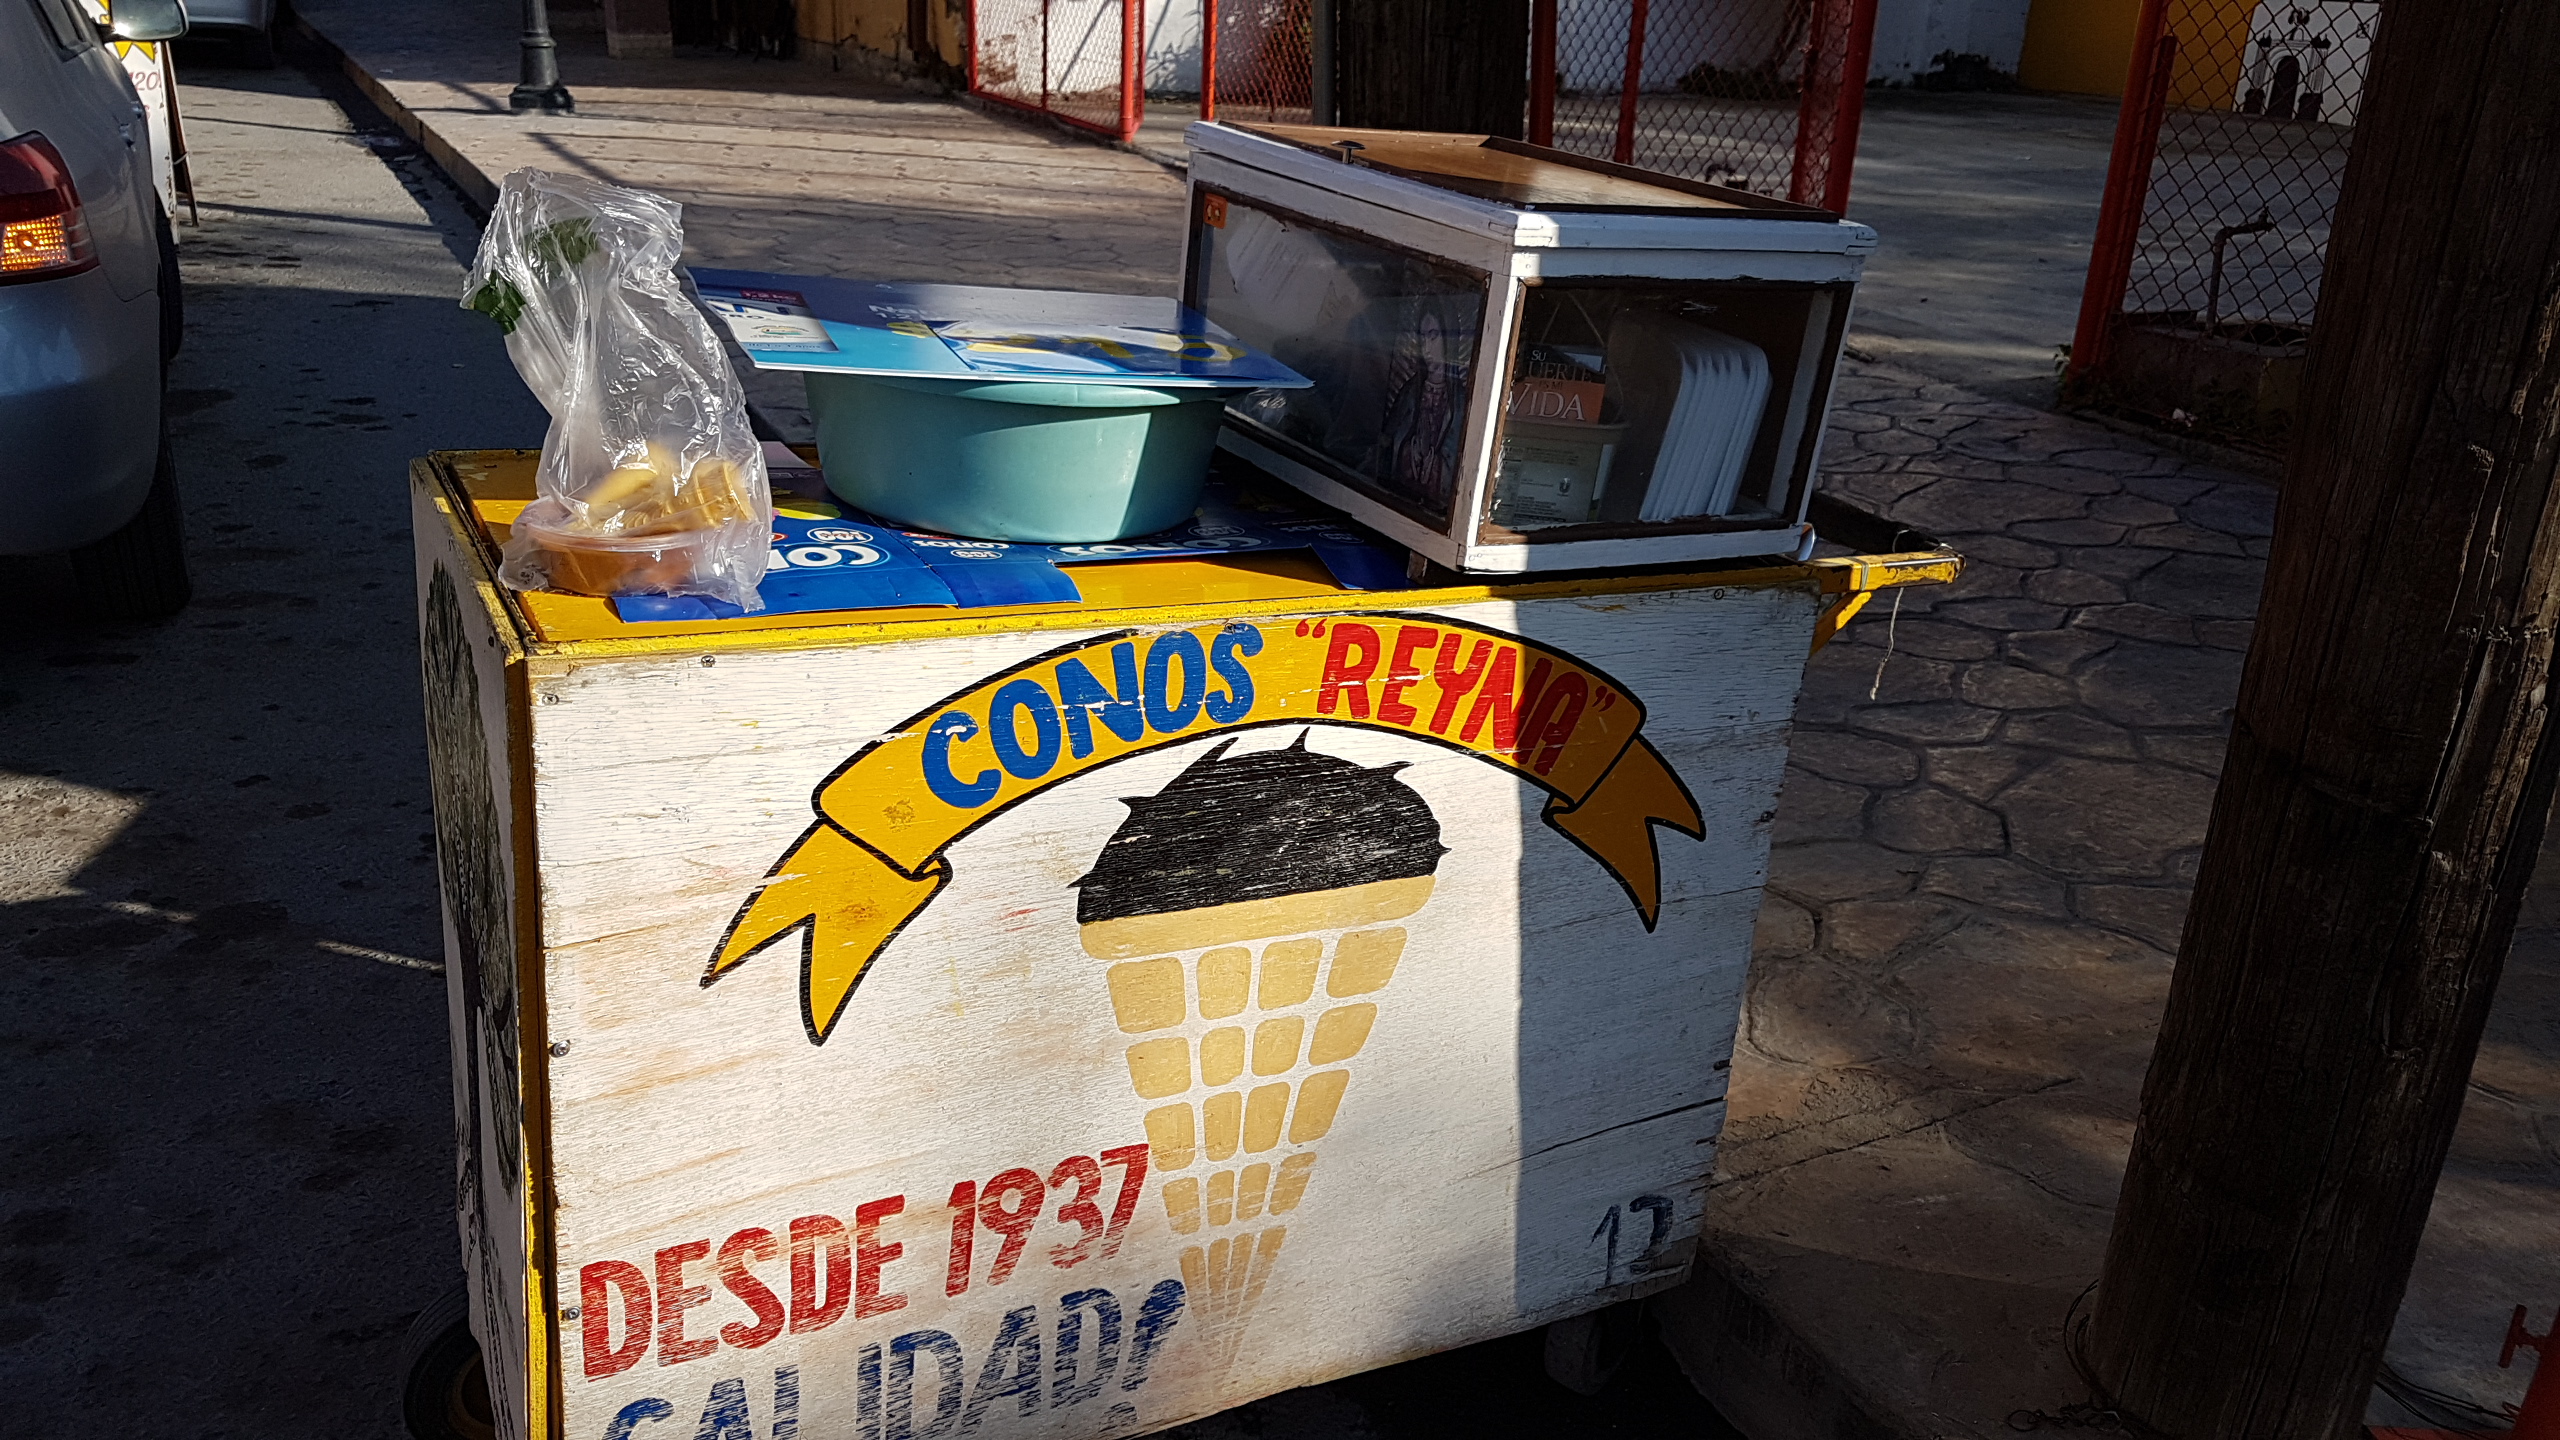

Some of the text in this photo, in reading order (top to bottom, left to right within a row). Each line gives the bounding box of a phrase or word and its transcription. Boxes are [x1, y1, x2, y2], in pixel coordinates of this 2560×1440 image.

[1530, 349, 1548, 362] SU
[1506, 382, 1585, 422] VIDA
[921, 622, 1264, 809] CONOS
[578, 1194, 909, 1383] DESDE
[944, 1143, 1149, 1298] 1937
[1585, 1195, 1675, 1285] 12
